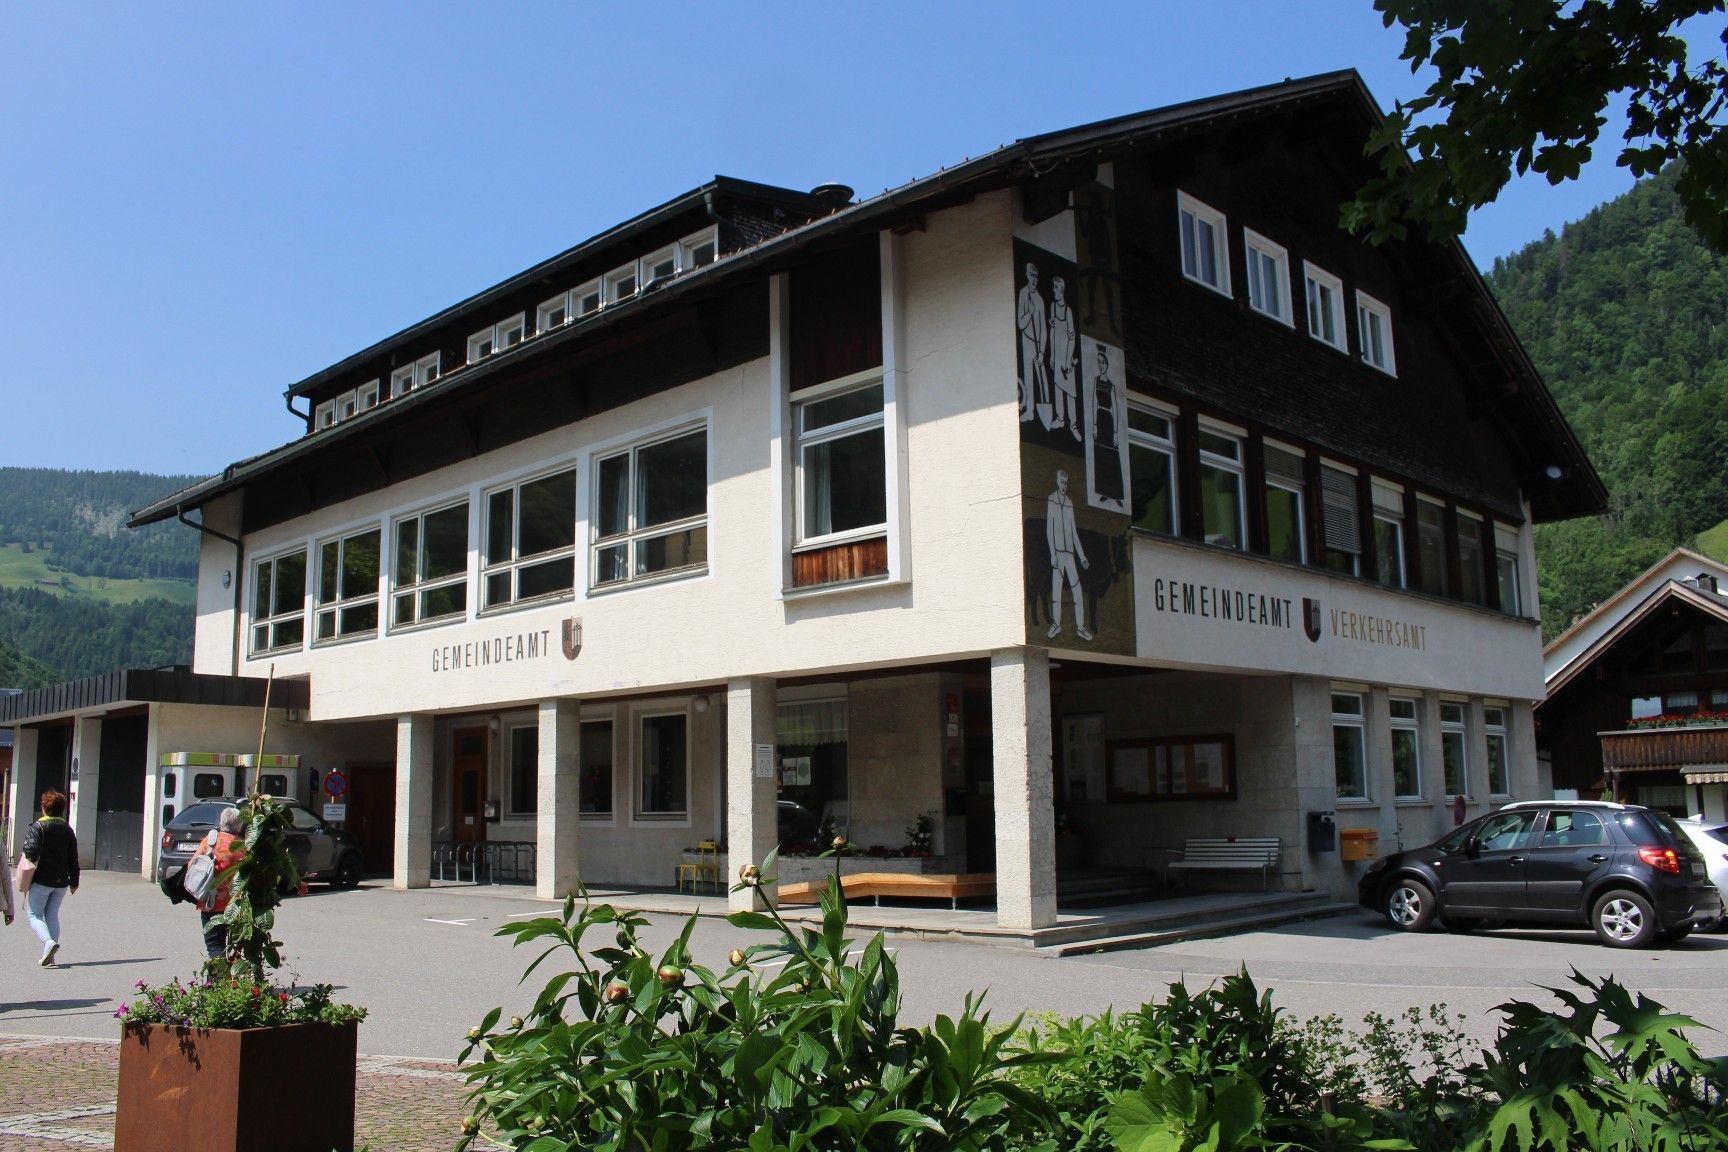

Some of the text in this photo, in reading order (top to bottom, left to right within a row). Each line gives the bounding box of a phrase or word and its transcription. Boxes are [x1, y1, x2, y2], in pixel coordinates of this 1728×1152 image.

[1154, 578, 1426, 650] GEMEINDEAMT VERKEHRSAMT
[432, 630, 550, 672] GEMEINDEAMT
